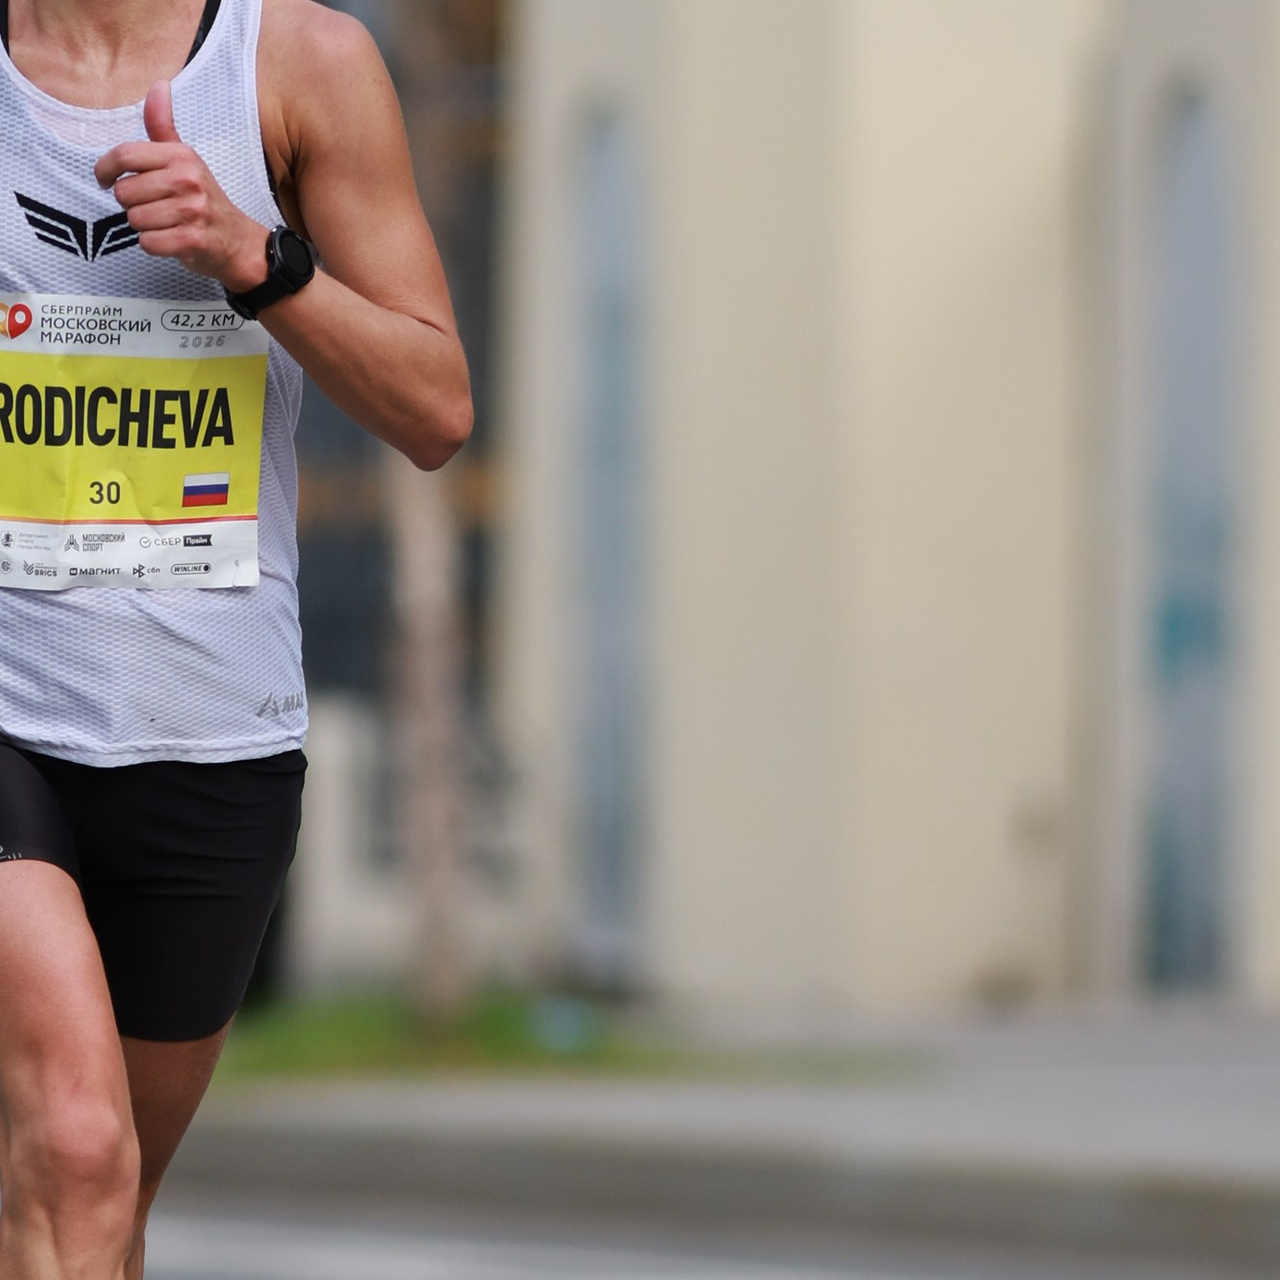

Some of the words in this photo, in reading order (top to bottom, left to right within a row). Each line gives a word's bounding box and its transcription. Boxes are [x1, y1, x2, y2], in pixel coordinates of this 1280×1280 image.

[41, 304, 123, 316] СБЕРПРАЙМ
[40, 317, 152, 333] МОСКОВСКИЙ
[170, 313, 206, 329] 42,2
[40, 331, 121, 345] МАРАФОН
[179, 335, 226, 348] 2026
[89, 481, 121, 505] 30
[82, 532, 126, 543] МОСКОВСКИЙ
[154, 537, 181, 547] СБЕР
[82, 543, 104, 552] СПОРТ
[34, 568, 58, 577] BRICS
[174, 565, 203, 573] WINLINE
